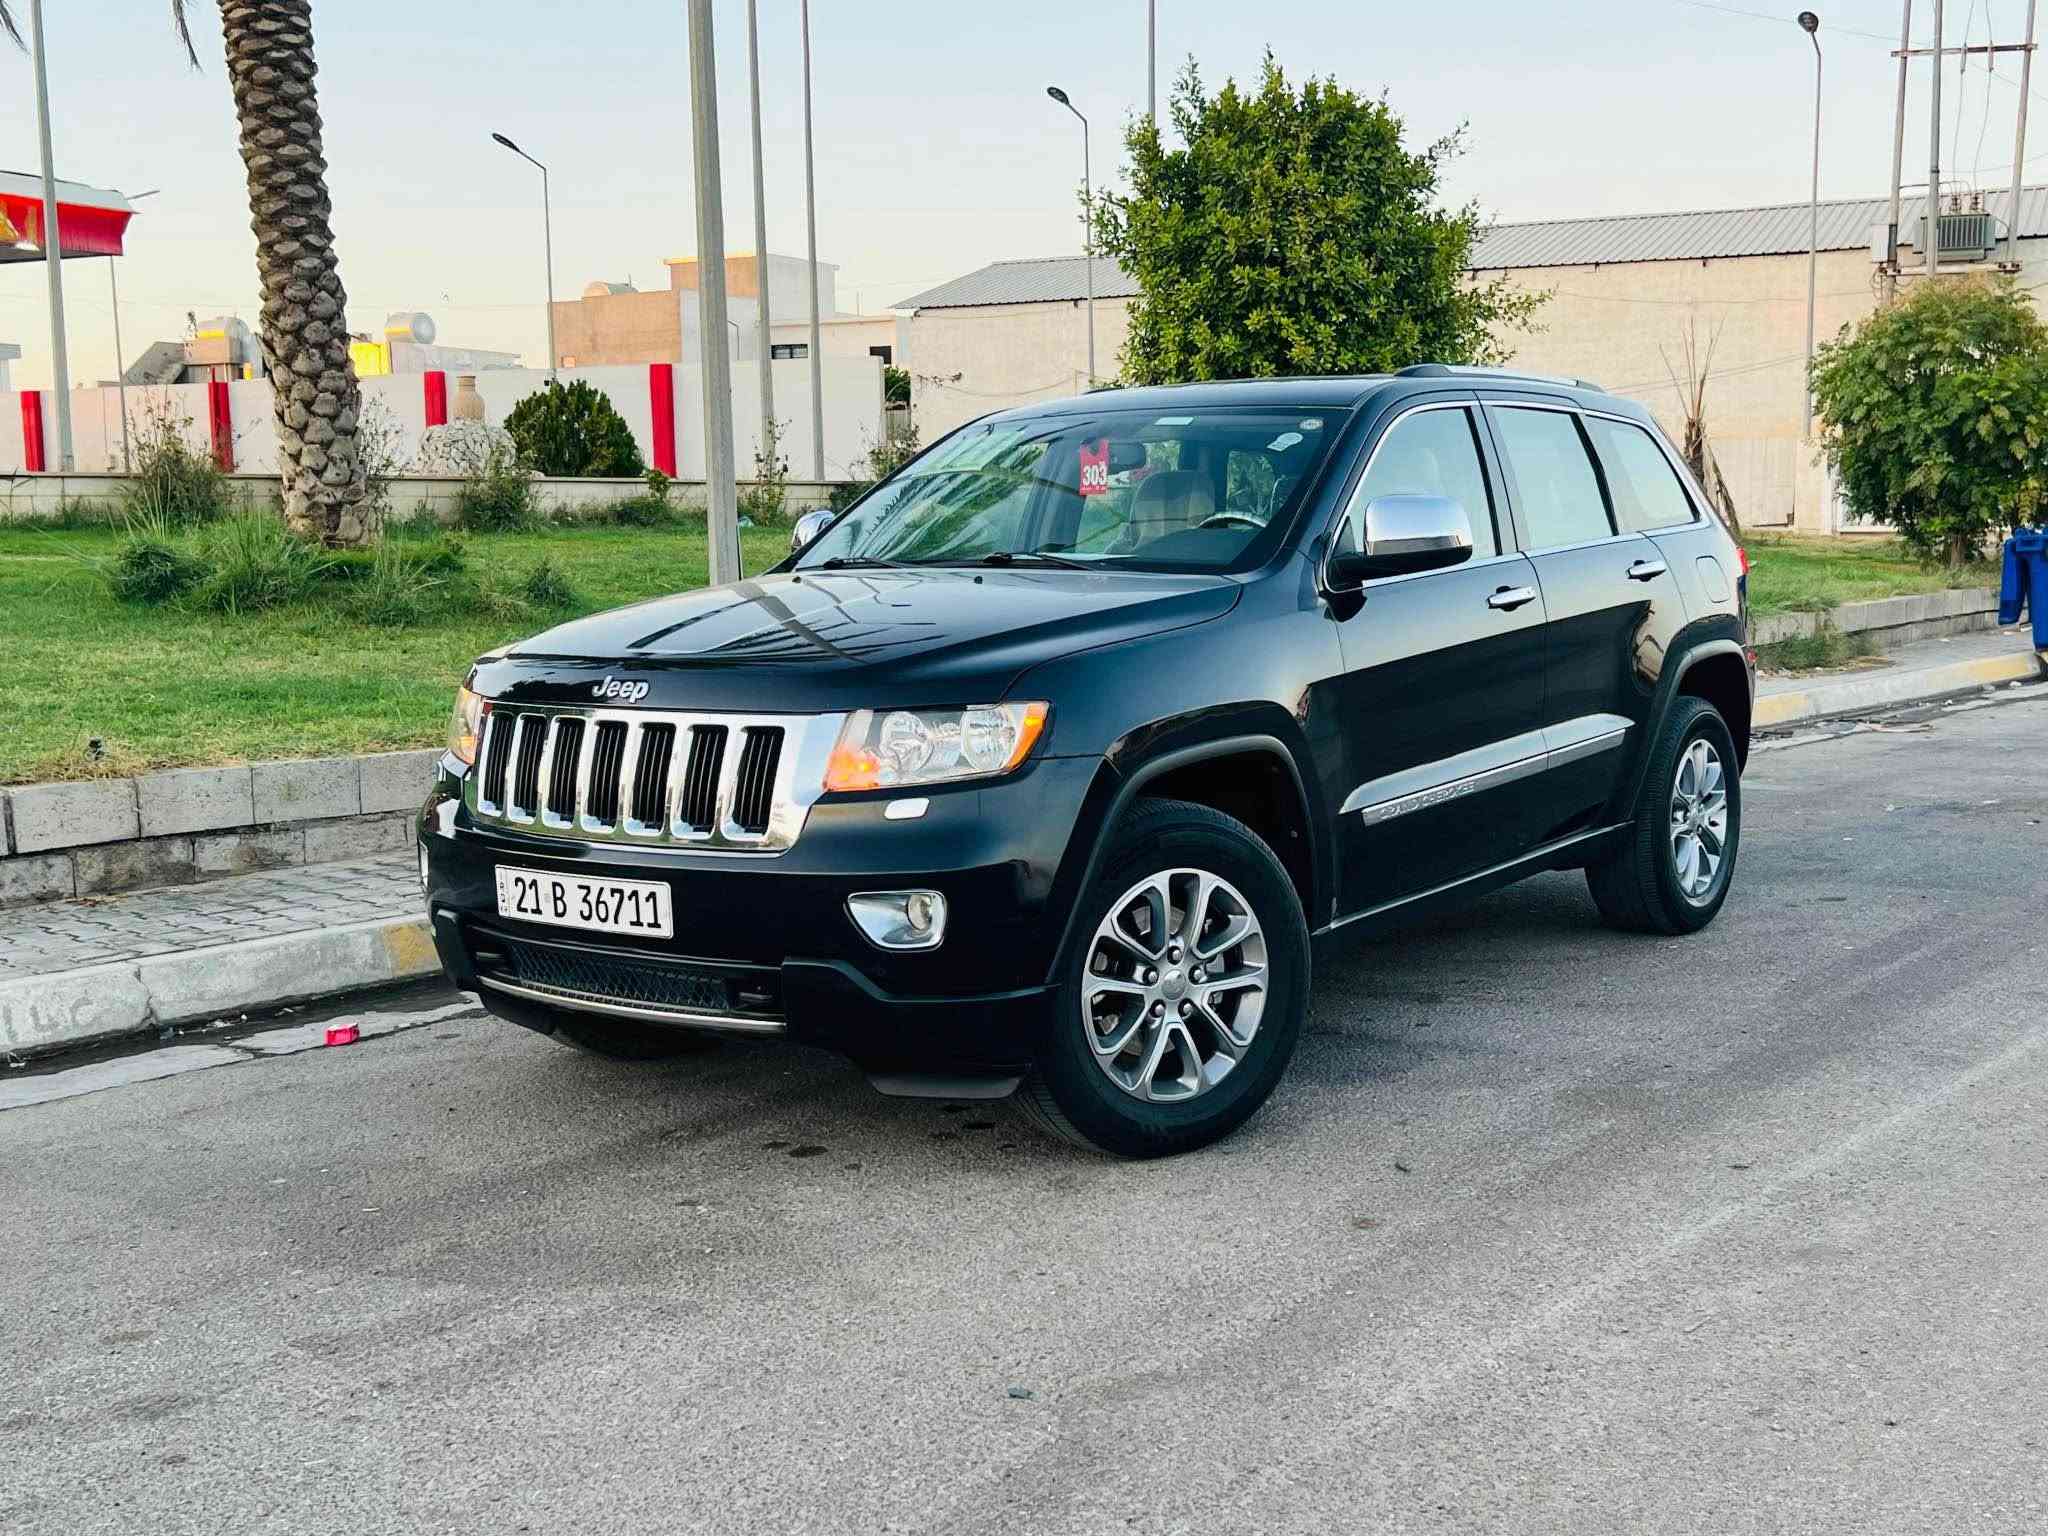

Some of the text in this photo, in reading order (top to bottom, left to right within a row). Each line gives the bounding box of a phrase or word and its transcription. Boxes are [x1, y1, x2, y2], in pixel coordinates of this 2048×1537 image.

[1083, 463, 1106, 486] 303
[592, 675, 649, 704] Jeep
[514, 877, 543, 915] 21
[551, 881, 567, 918] B
[577, 884, 662, 929] 36711
